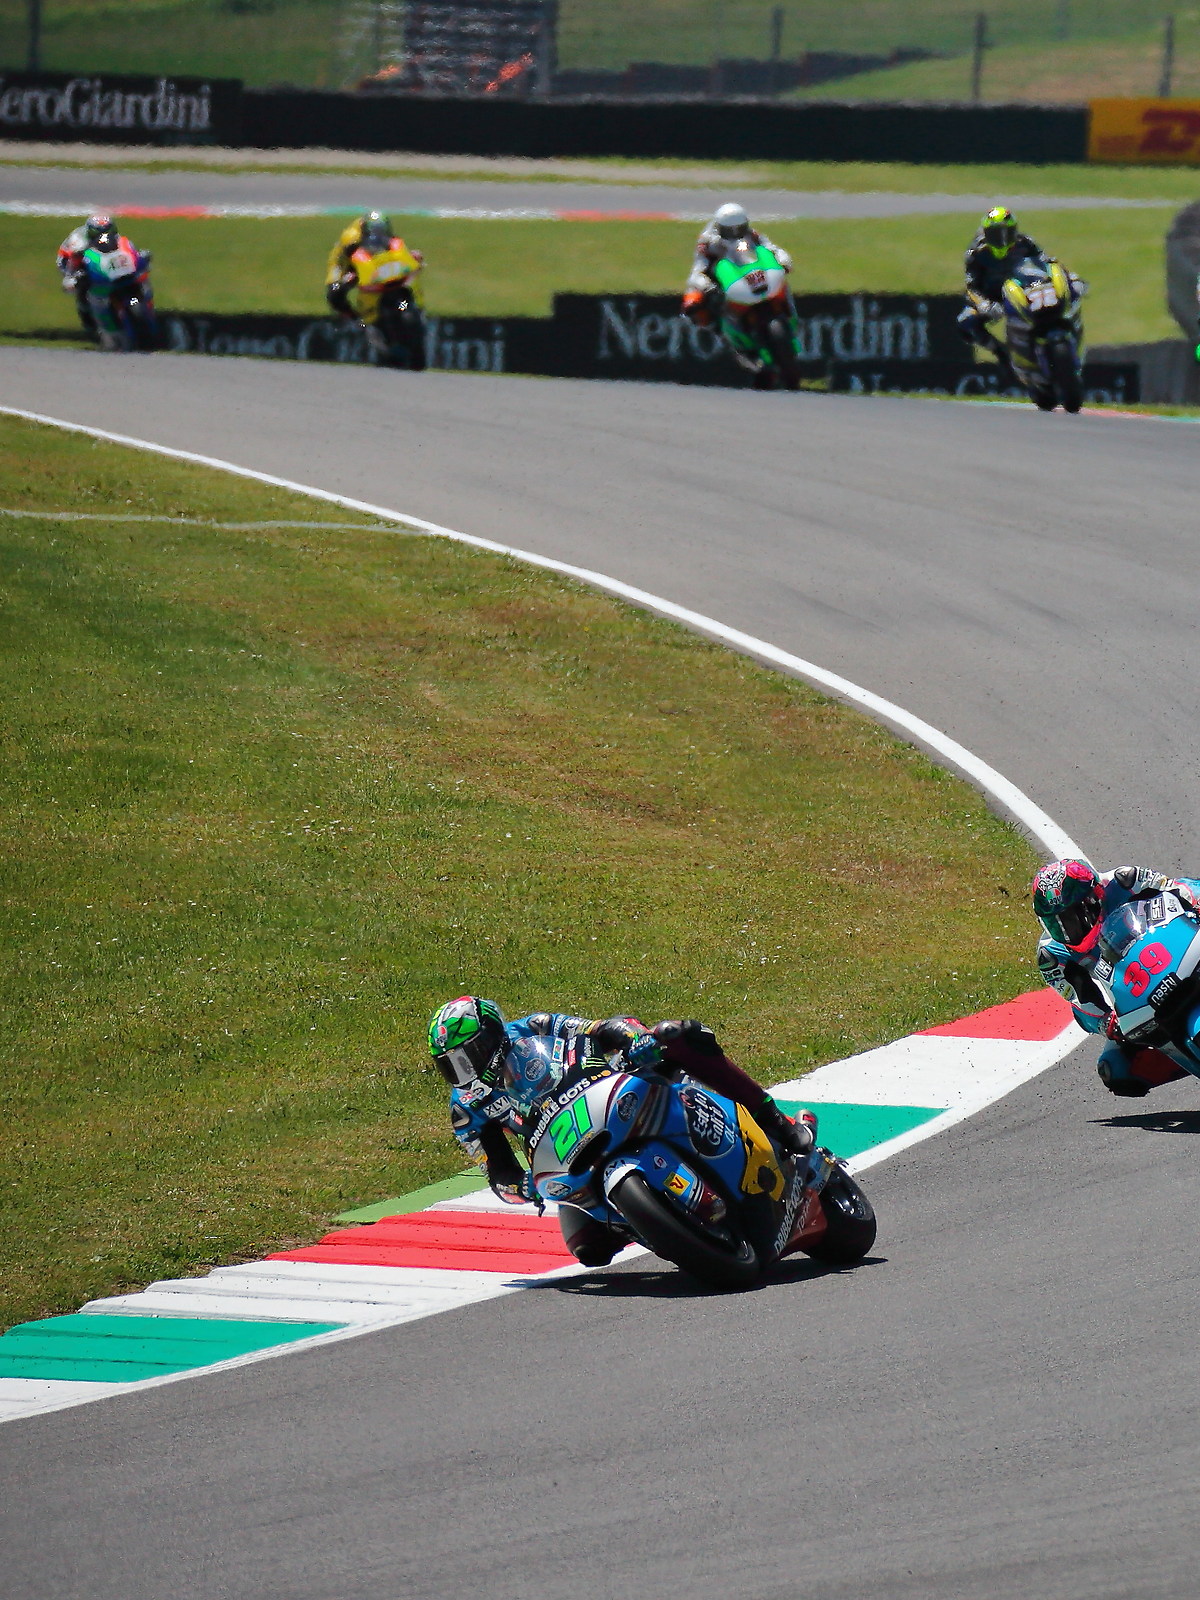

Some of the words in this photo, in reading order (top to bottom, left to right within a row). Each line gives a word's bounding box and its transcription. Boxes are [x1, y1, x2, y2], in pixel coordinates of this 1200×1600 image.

[0, 78, 210, 128] eroGiardini
[1123, 941, 1173, 997] 39
[1151, 974, 1177, 1006] nashi
[529, 1101, 560, 1149] DRIBBLE
[548, 1093, 595, 1166] 21
